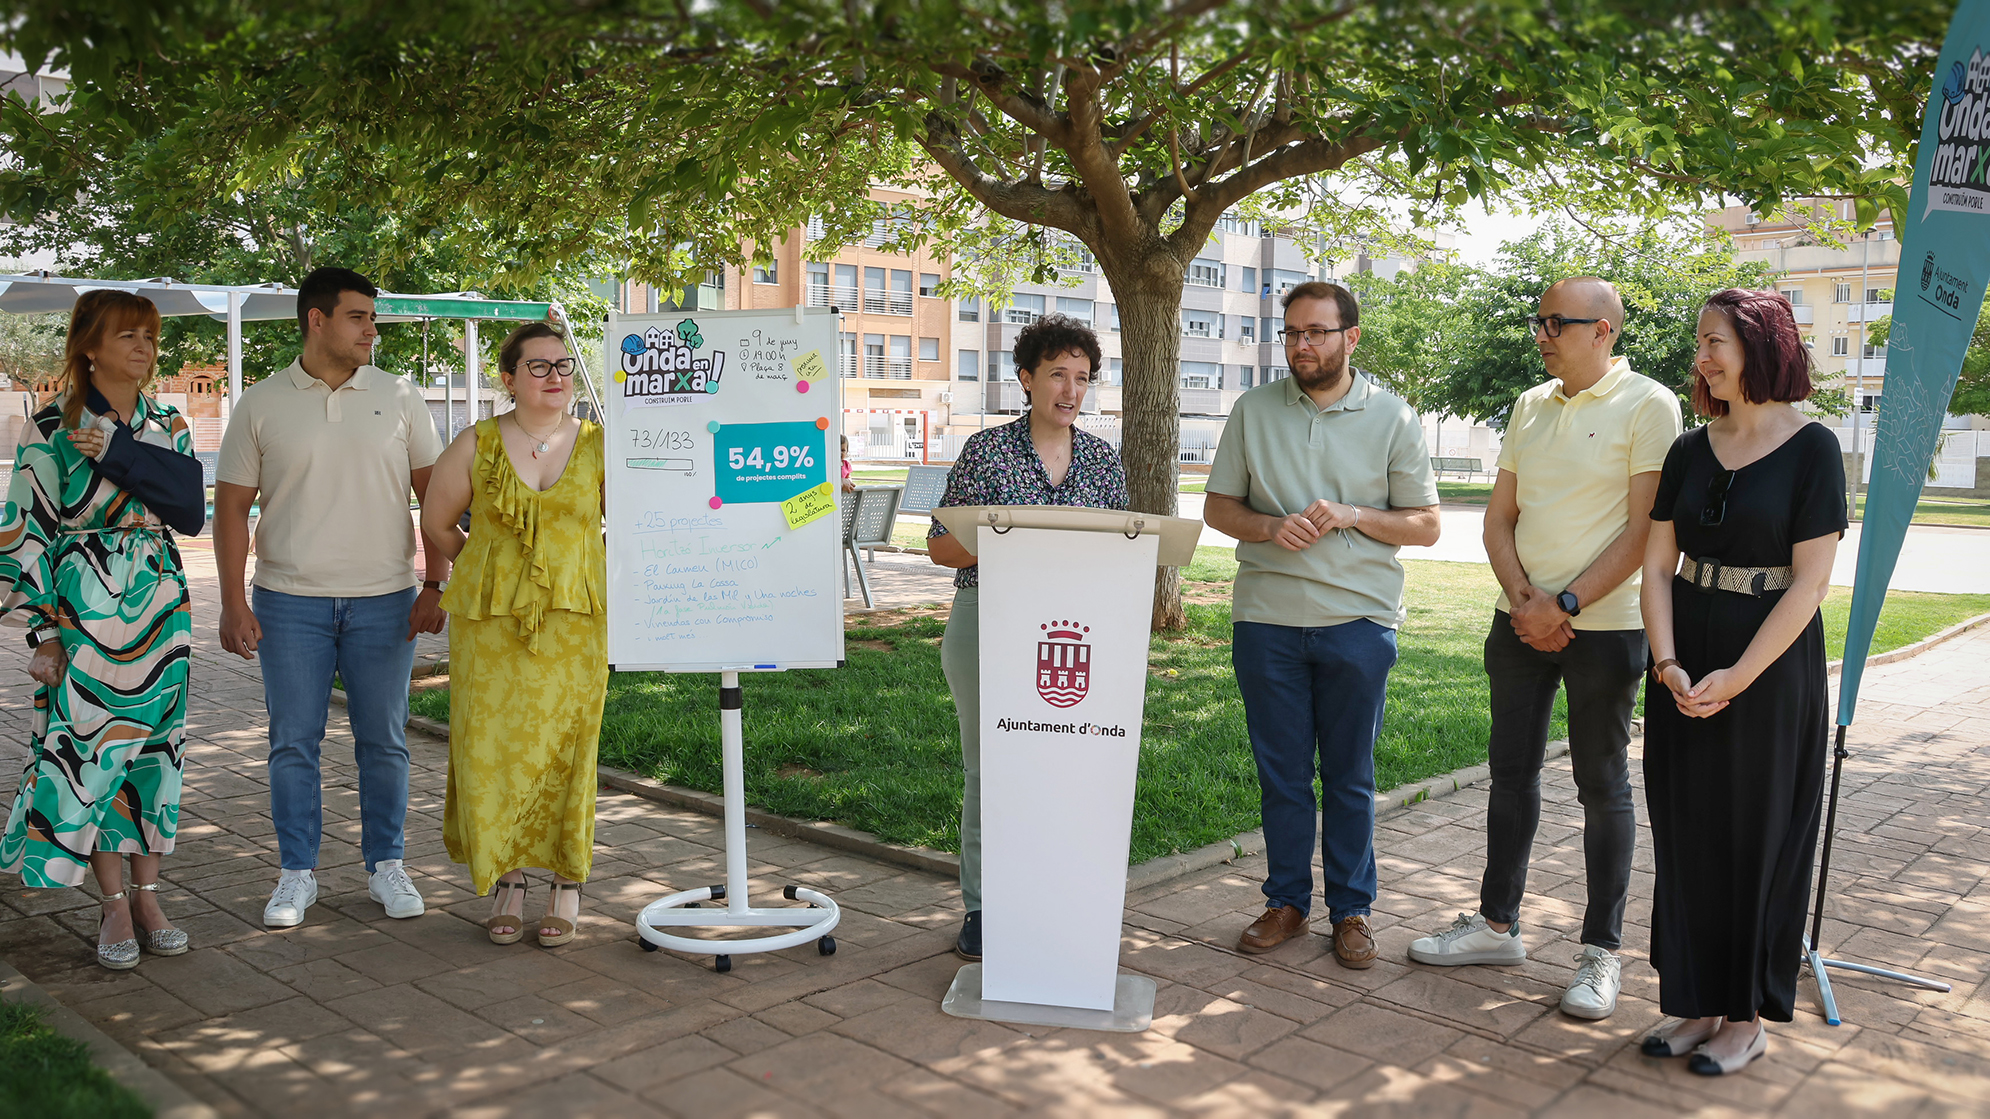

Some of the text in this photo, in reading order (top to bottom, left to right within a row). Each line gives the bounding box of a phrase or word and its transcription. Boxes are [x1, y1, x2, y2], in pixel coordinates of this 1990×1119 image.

[1931, 142, 1990, 187] marx
[1934, 266, 1969, 294] Ajuntament
[1935, 284, 1960, 310] Onda
[752, 329, 798, 352] 9 de juny
[622, 346, 710, 374] Onda en
[750, 362, 784, 373] Plaça 8
[630, 428, 695, 450] 73/133
[728, 445, 815, 473] 54,9%
[745, 473, 777, 483] projectes
[777, 473, 807, 482] complits
[785, 490, 818, 515] 2 anys
[804, 502, 814, 510] de
[669, 513, 723, 534] projectes
[699, 535, 757, 556] Inversor
[644, 564, 659, 577] El
[644, 579, 687, 596] Parking
[691, 579, 705, 589] La
[704, 592, 718, 602] las
[745, 594, 753, 606] y
[754, 588, 777, 600] Una
[780, 586, 818, 599] noches
[694, 618, 711, 626] con
[997, 718, 1126, 738] Ajuntament d'Onda
